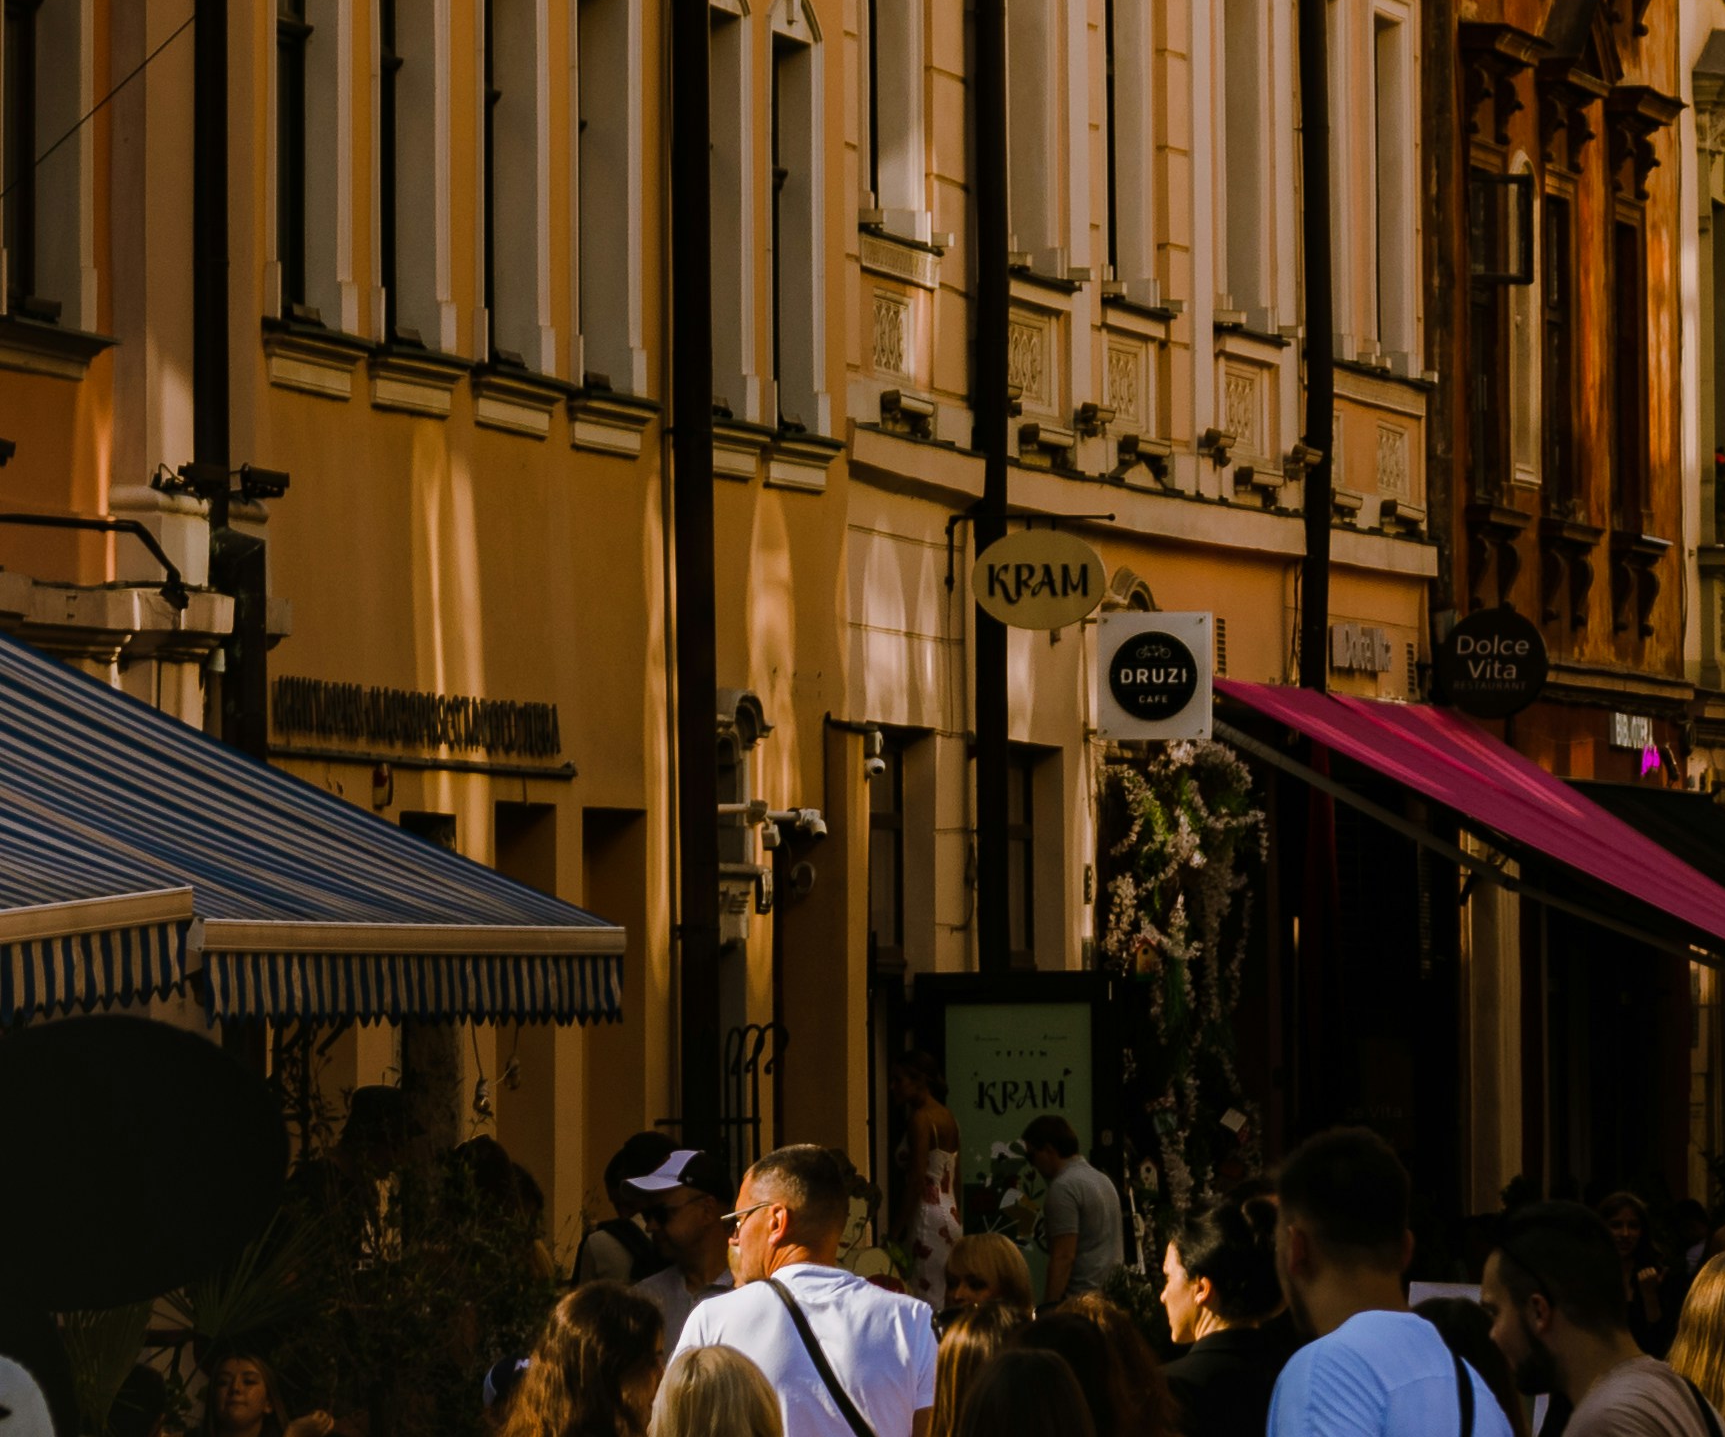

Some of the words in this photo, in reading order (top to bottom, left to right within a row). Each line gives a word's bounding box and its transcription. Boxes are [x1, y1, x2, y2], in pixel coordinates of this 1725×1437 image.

[987, 563, 1088, 605] KRAM
[1456, 634, 1530, 655] Dolce
[1120, 667, 1187, 684] DRUZI
[1467, 658, 1517, 679] Vita
[1452, 680, 1526, 691] RESTAURANT
[1138, 693, 1168, 704] CAFE
[977, 1080, 1065, 1115] KRAM
